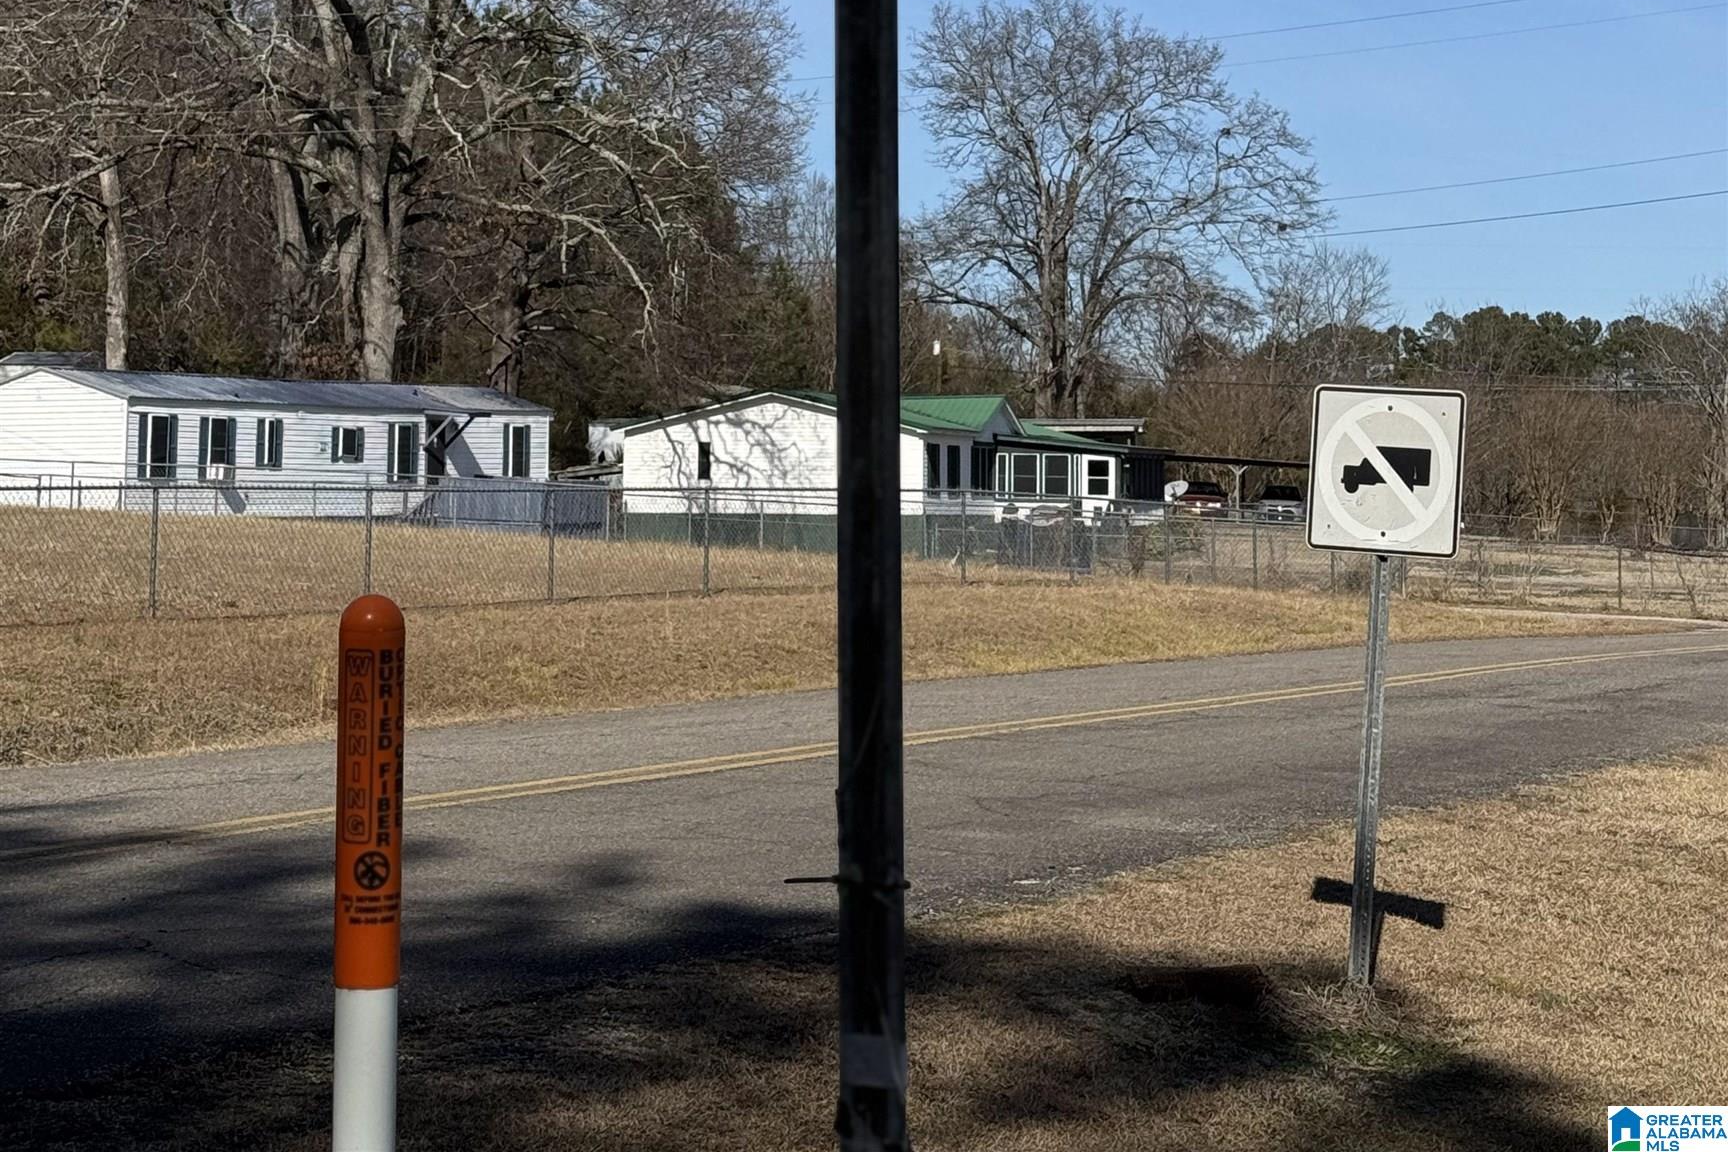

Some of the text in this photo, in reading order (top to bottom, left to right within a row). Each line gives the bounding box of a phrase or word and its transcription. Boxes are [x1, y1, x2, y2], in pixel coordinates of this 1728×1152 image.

[346, 653, 370, 837] WARNING
[376, 648, 393, 848] BURIED FIBER
